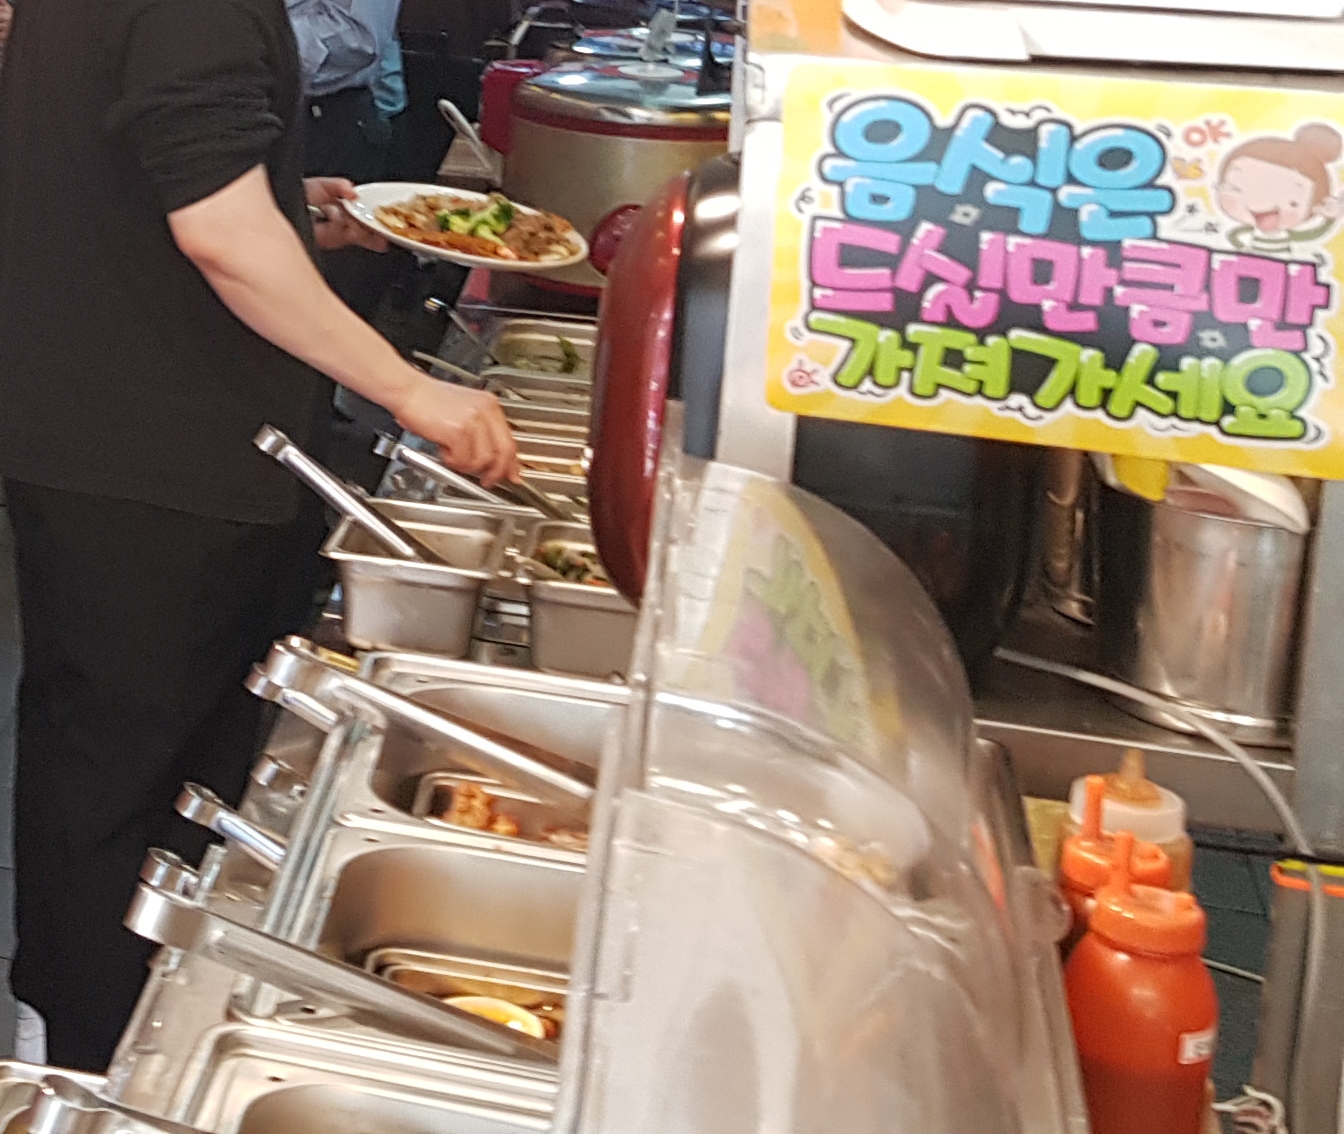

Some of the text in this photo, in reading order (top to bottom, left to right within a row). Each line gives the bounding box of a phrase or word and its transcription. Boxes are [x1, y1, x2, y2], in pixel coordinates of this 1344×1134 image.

[820, 96, 1174, 241] 음식은
[811, 219, 1330, 351] 드실만큼만
[808, 312, 1313, 439] 가져가세요
